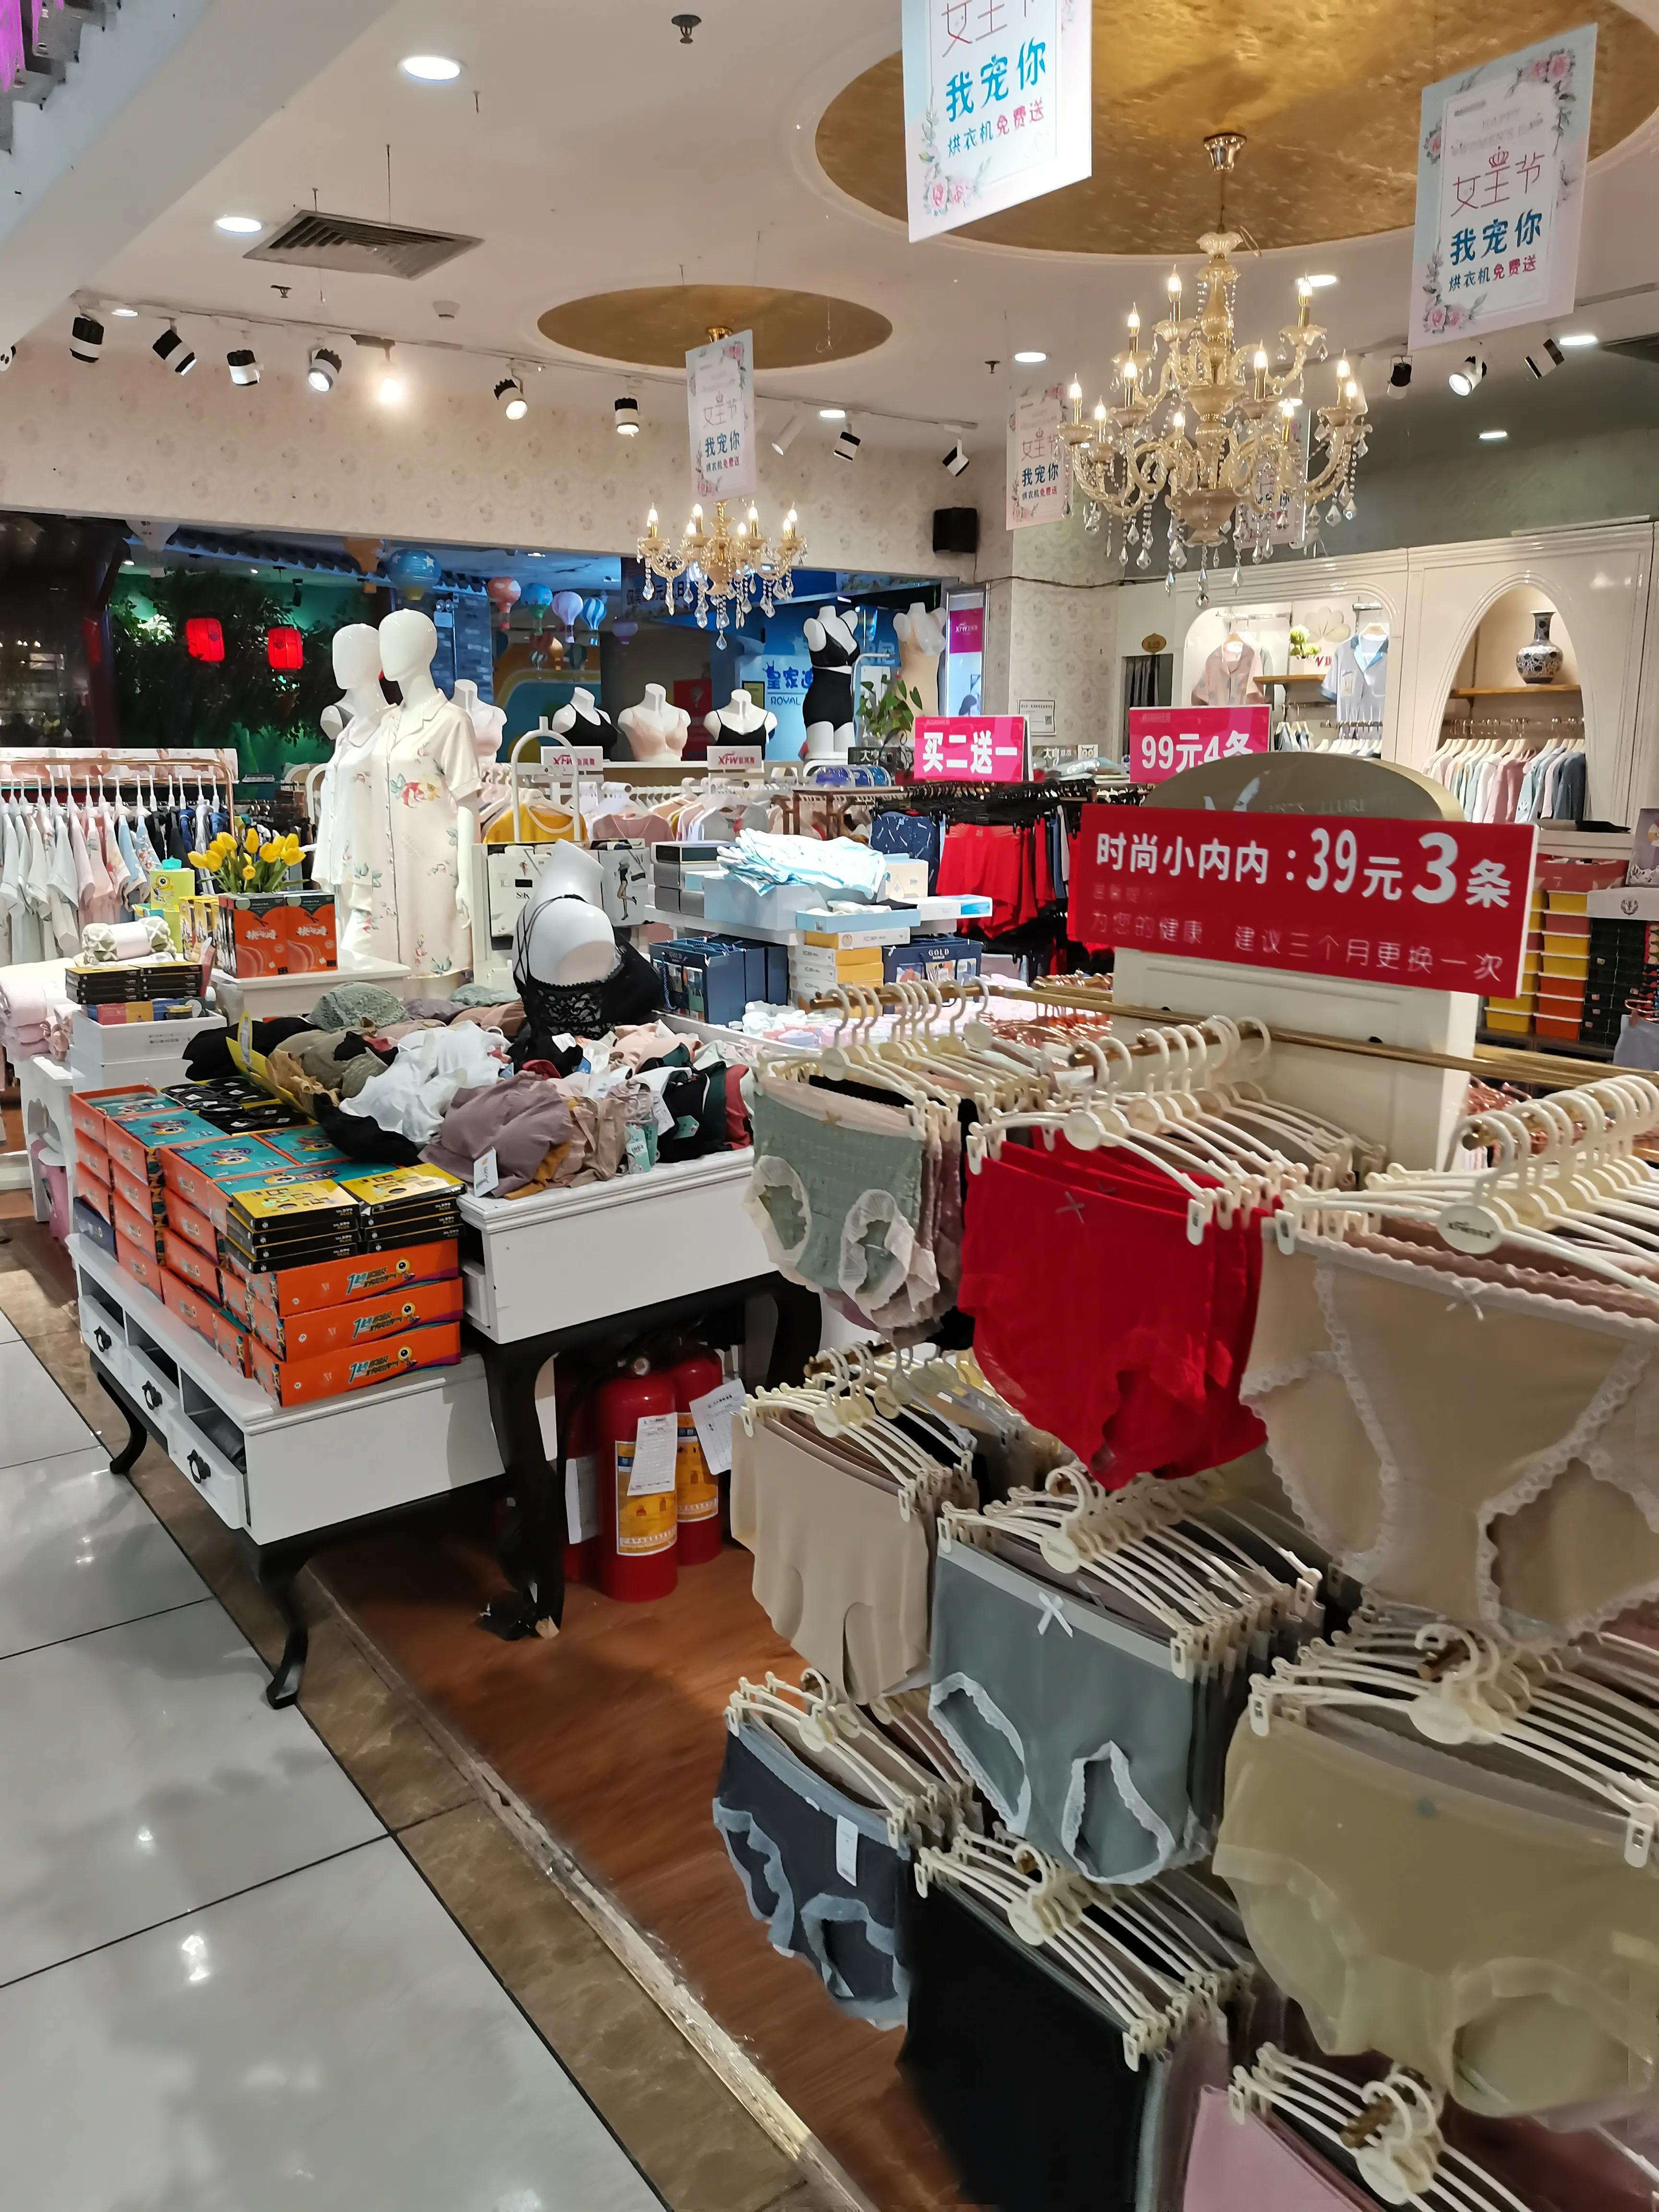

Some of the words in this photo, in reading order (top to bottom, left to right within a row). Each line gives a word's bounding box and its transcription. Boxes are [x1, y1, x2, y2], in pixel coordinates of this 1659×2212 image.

[941, 0, 1034, 58] 女王
[946, 37, 1046, 122] 我宠你
[947, 96, 1045, 158] 烘衣机免费送
[1451, 152, 1545, 217] 女王节
[1450, 209, 1542, 265] 我宠你
[1448, 255, 1537, 292] 烘衣机免费送
[705, 430, 740, 457] 我宠你
[1022, 463, 1059, 488] 我宠你
[770, 696, 801, 706] ROYAL
[923, 730, 1018, 774] 买二送一
[928, 948, 950, 956] GOLD
